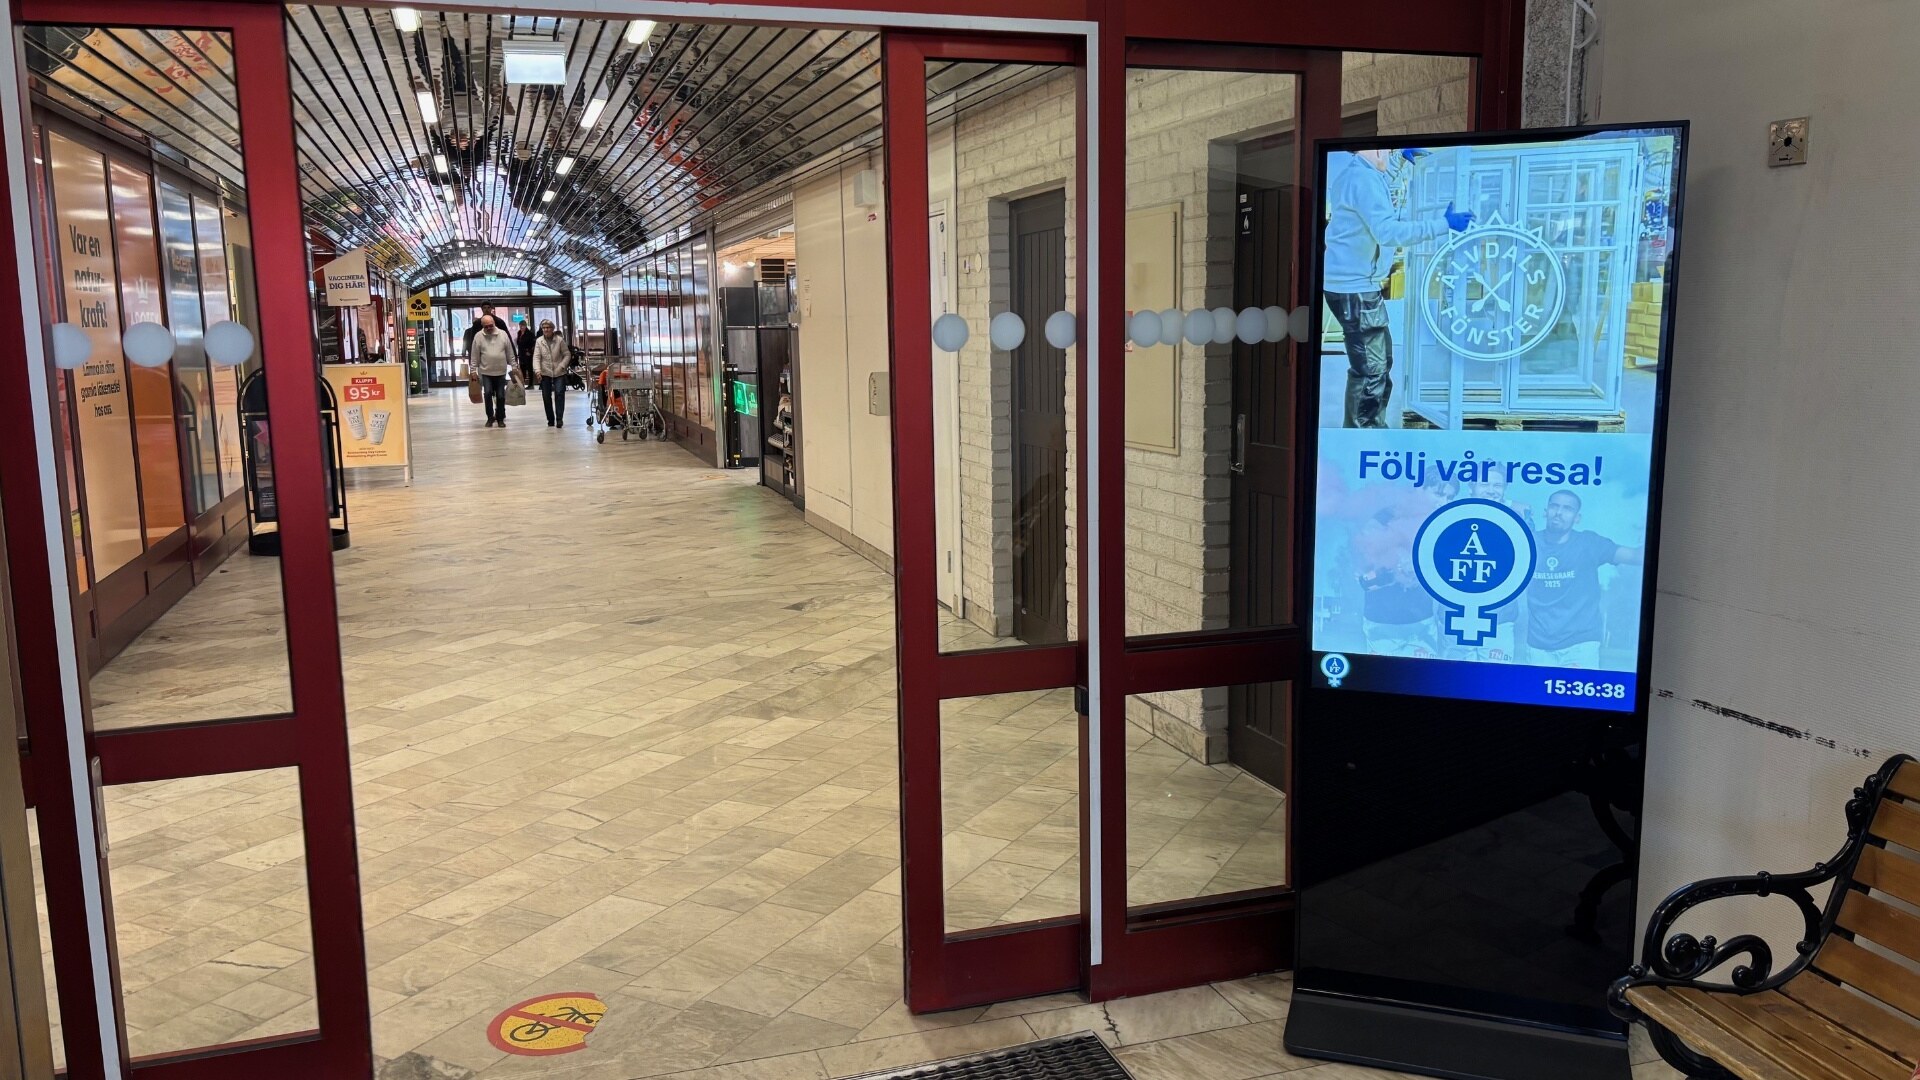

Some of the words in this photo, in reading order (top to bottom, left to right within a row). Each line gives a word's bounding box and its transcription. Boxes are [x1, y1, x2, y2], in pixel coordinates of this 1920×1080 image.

[69, 224, 87, 255] Var
[88, 235, 101, 257] en
[1435, 242, 1546, 290] ÄLVDALS
[329, 282, 344, 290] DIG
[345, 281, 366, 289] HÄR!
[79, 298, 108, 328] kraft!
[1440, 303, 1545, 346] FÖNSTER
[349, 387, 370, 400] 95
[1359, 450, 1426, 488] Följ
[1435, 450, 1496, 483] vår
[1506, 456, 1603, 486] resa!
[1544, 679, 1625, 699] 15:36:38
